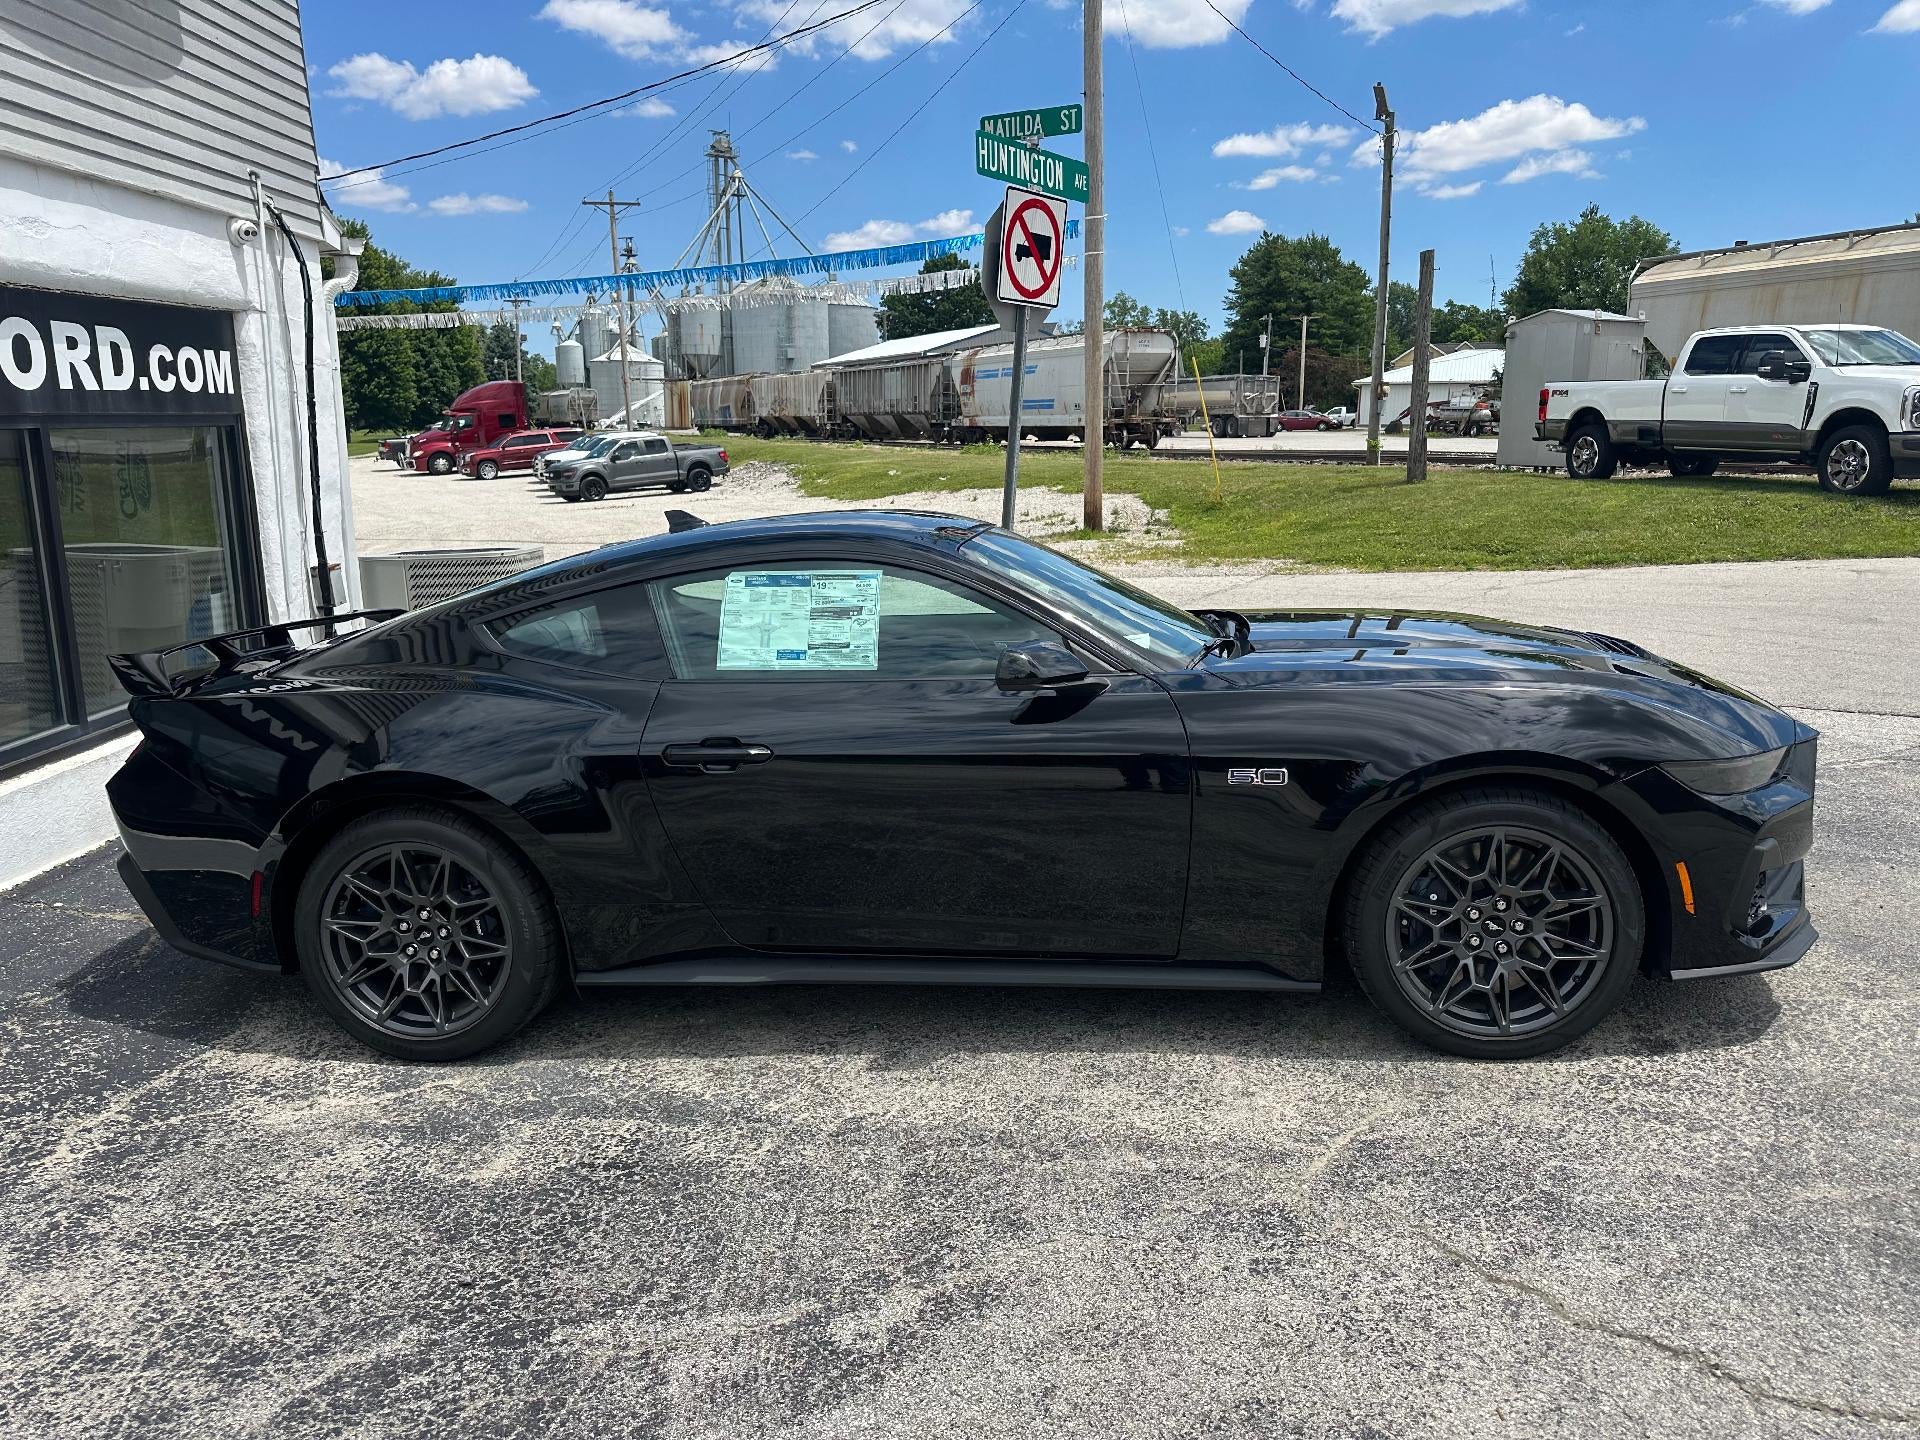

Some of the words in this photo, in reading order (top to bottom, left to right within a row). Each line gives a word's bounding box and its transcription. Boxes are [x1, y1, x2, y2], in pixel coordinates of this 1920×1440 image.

[984, 113, 1043, 137] MATILDA
[1060, 108, 1078, 131] ST
[978, 136, 1064, 191] HUNTINGTON
[1074, 172, 1088, 192] AVE
[0, 316, 235, 395] ORD.COM
[1228, 768, 1288, 786] 5.0
